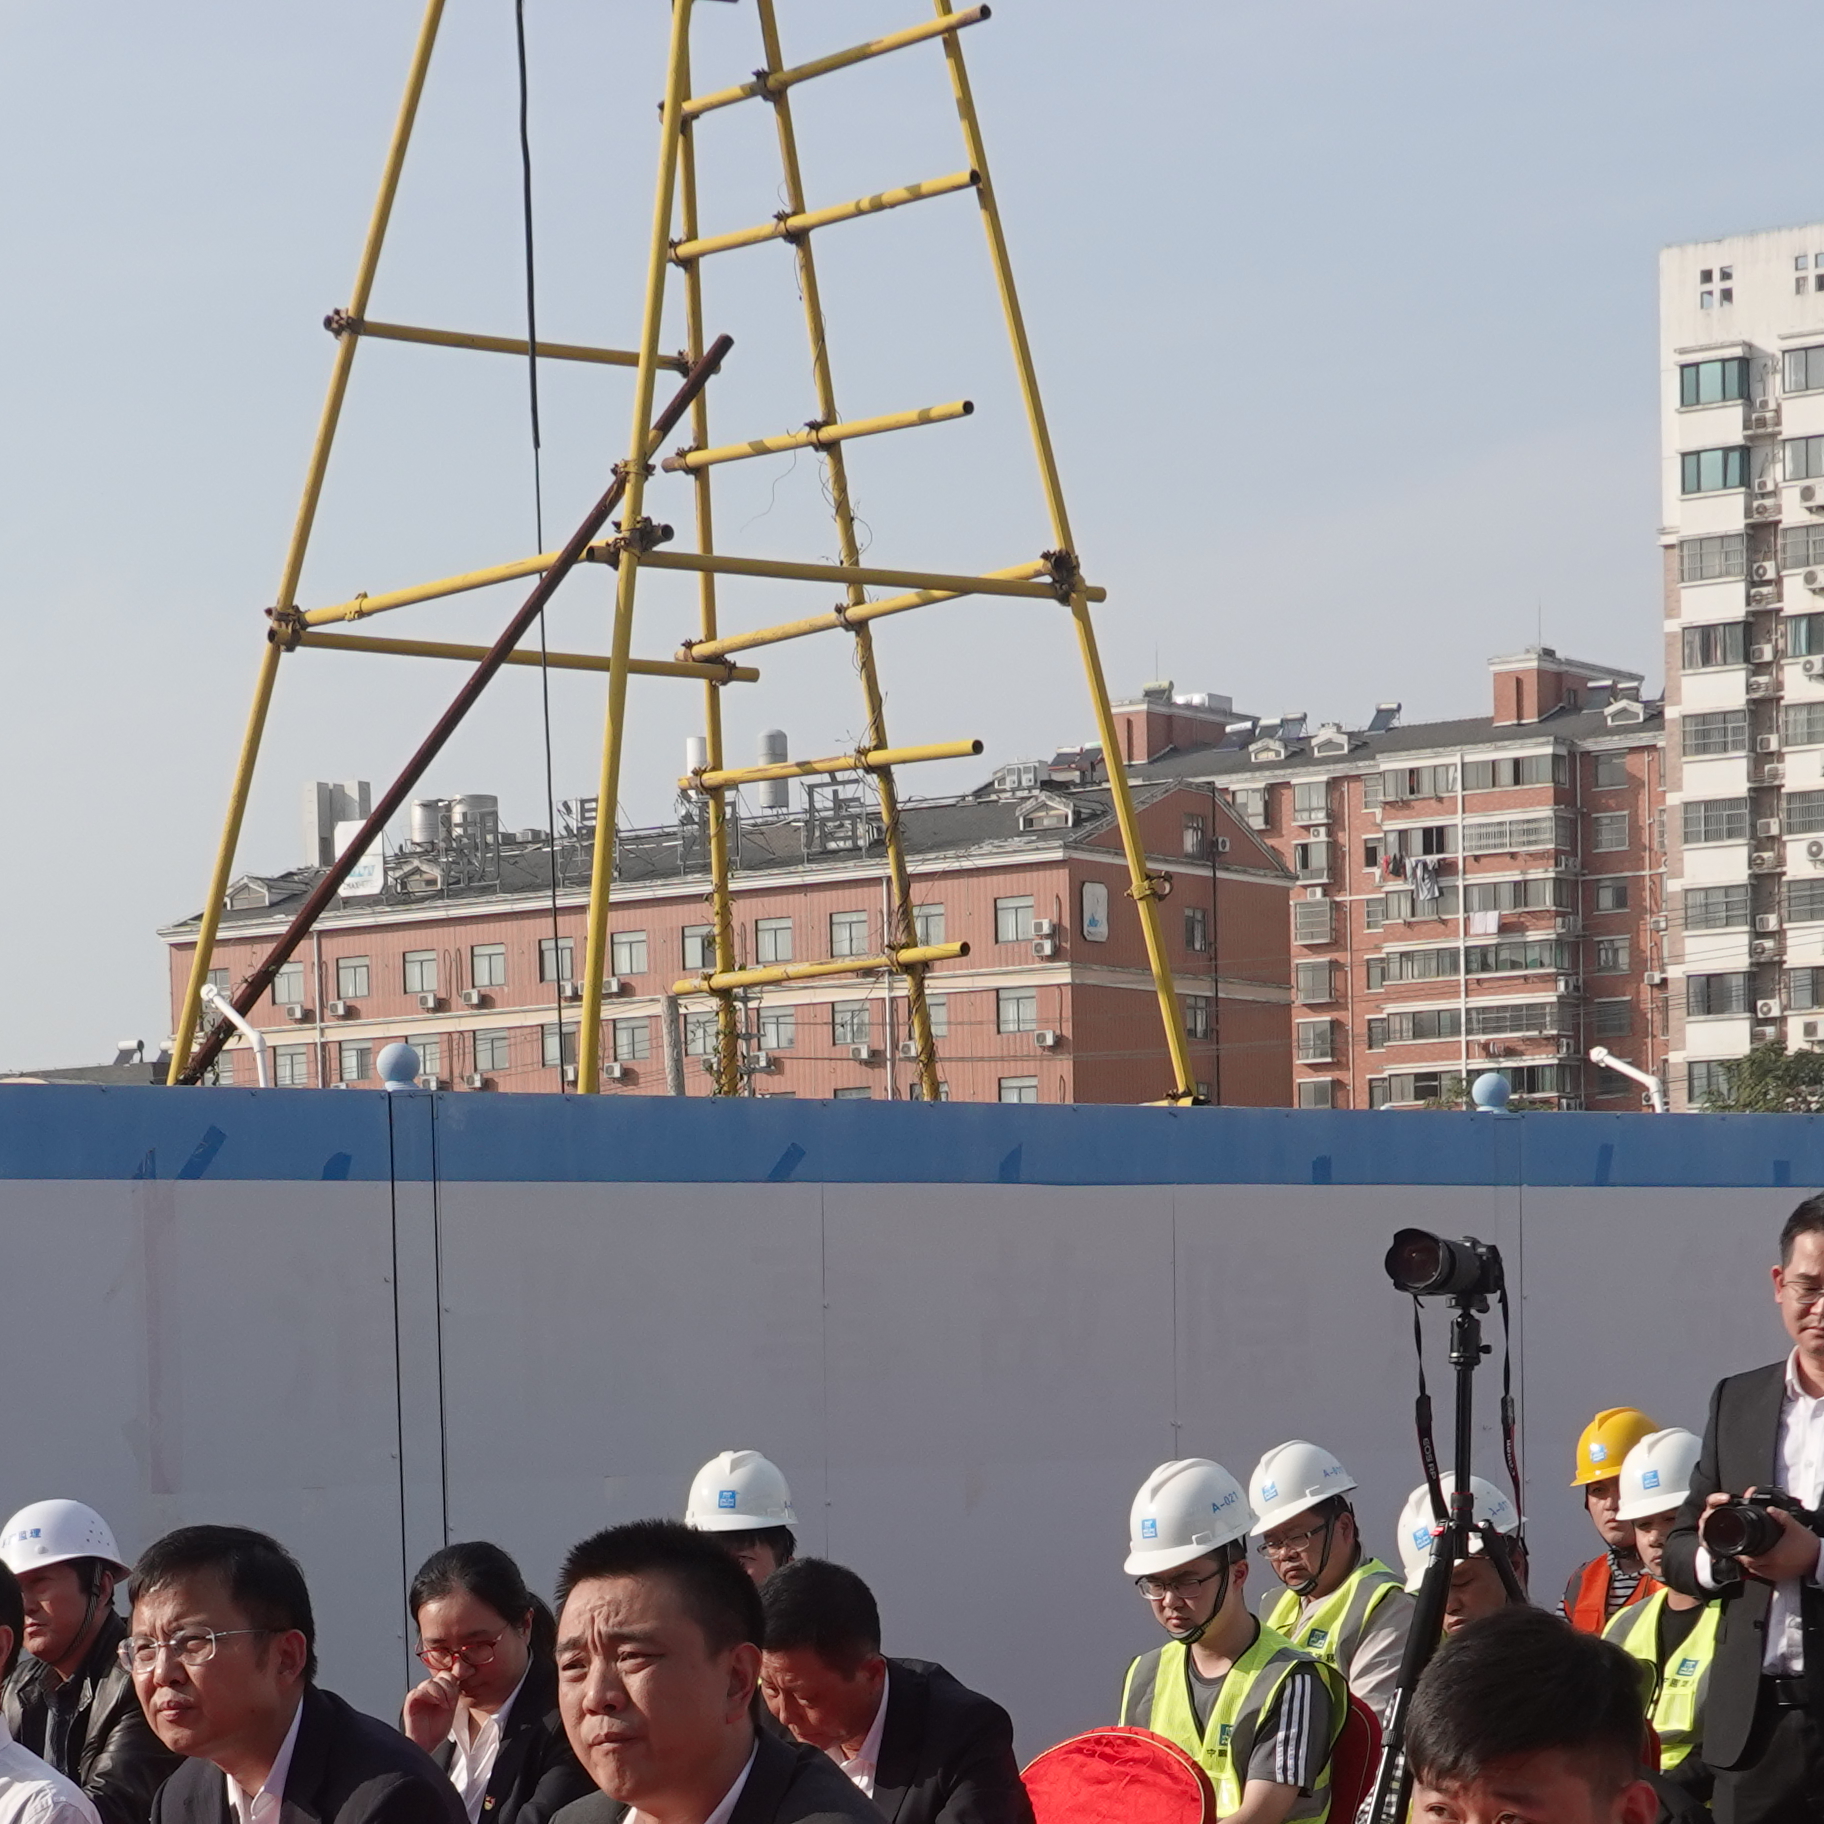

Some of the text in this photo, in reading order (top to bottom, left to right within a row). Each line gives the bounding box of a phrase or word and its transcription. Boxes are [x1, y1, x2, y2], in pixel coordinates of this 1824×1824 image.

[1428, 1463, 1436, 1480] RP
[1211, 1491, 1239, 1514] A-021
[2, 1528, 42, 1548] 监理
